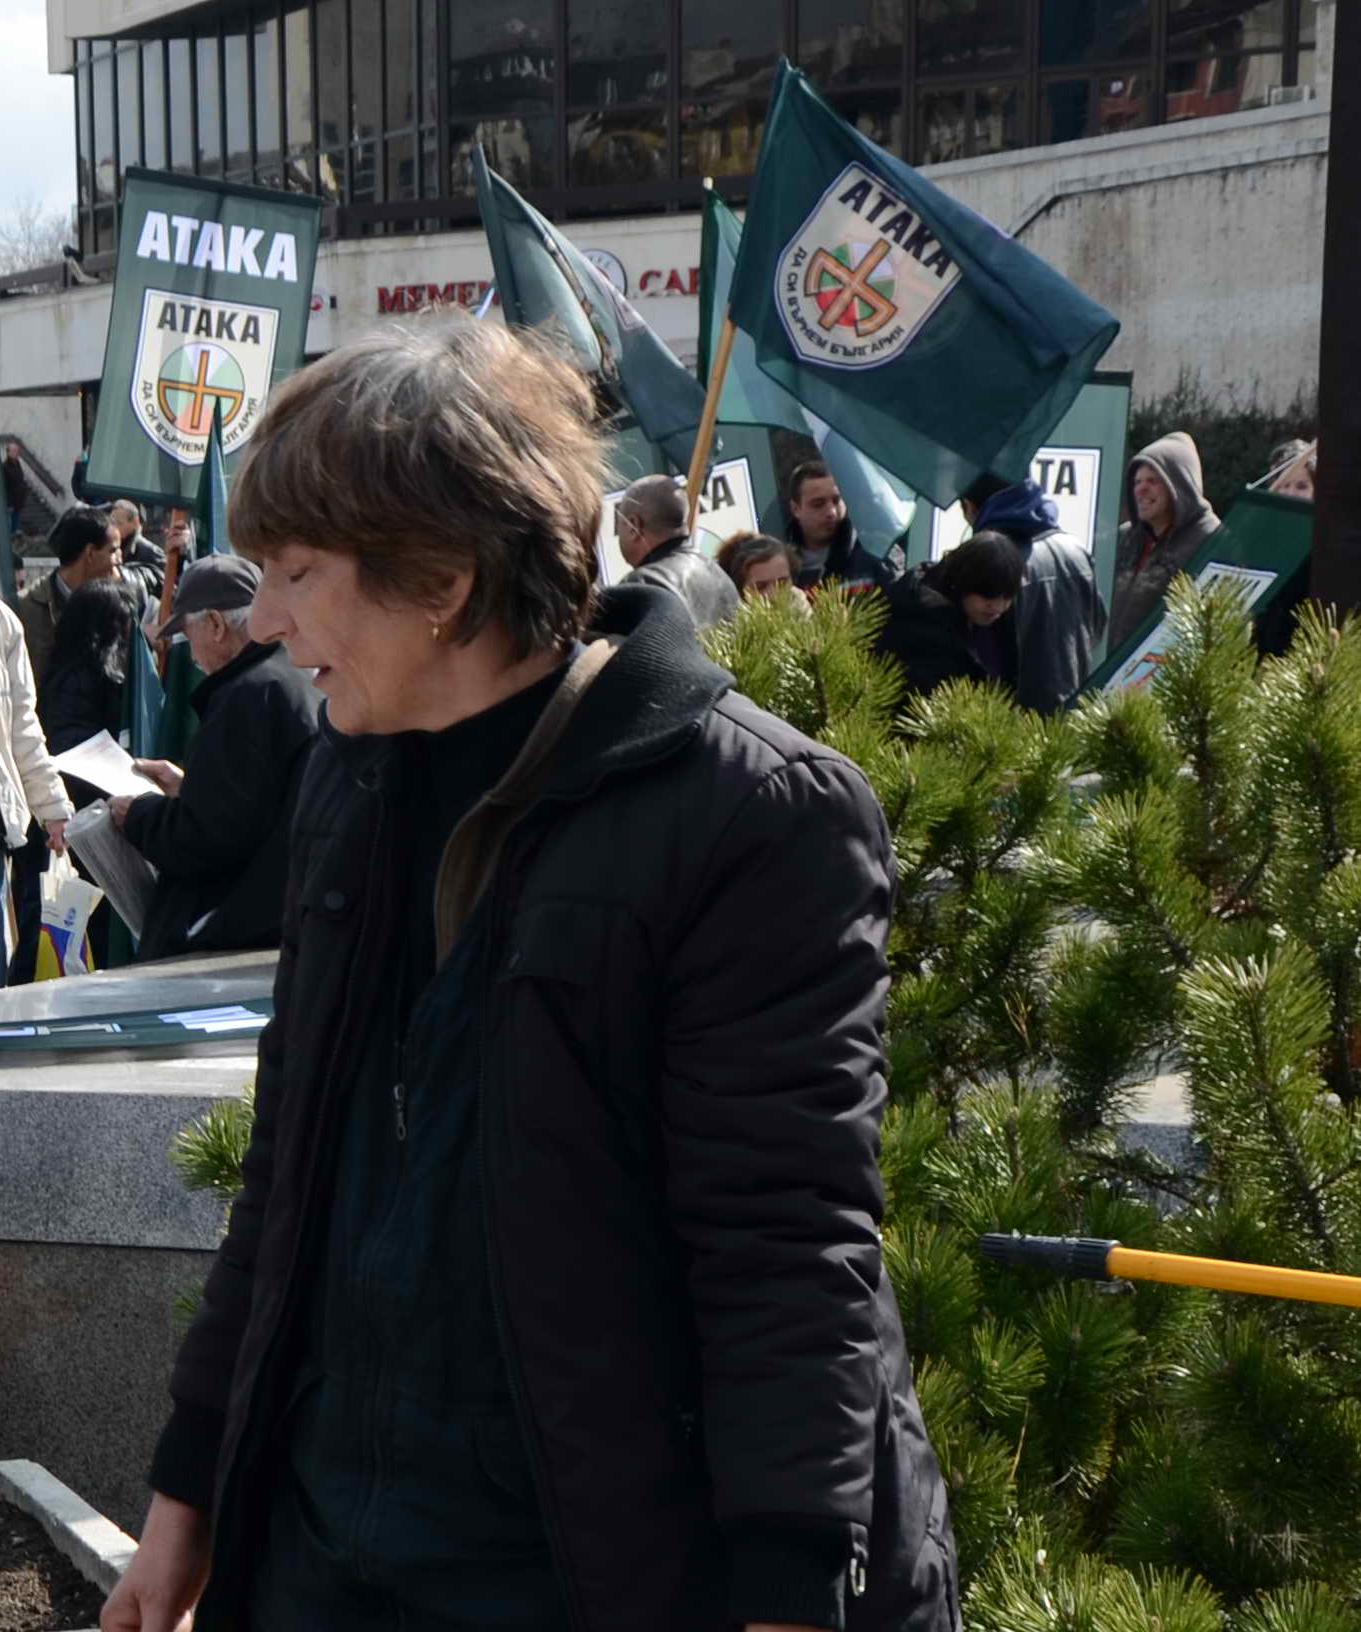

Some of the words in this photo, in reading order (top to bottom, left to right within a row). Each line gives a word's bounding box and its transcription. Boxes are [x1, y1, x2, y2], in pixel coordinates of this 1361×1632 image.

[137, 210, 298, 282] АТАКА
[839, 179, 953, 279] АТАКА
[158, 302, 260, 345] АТАКА
